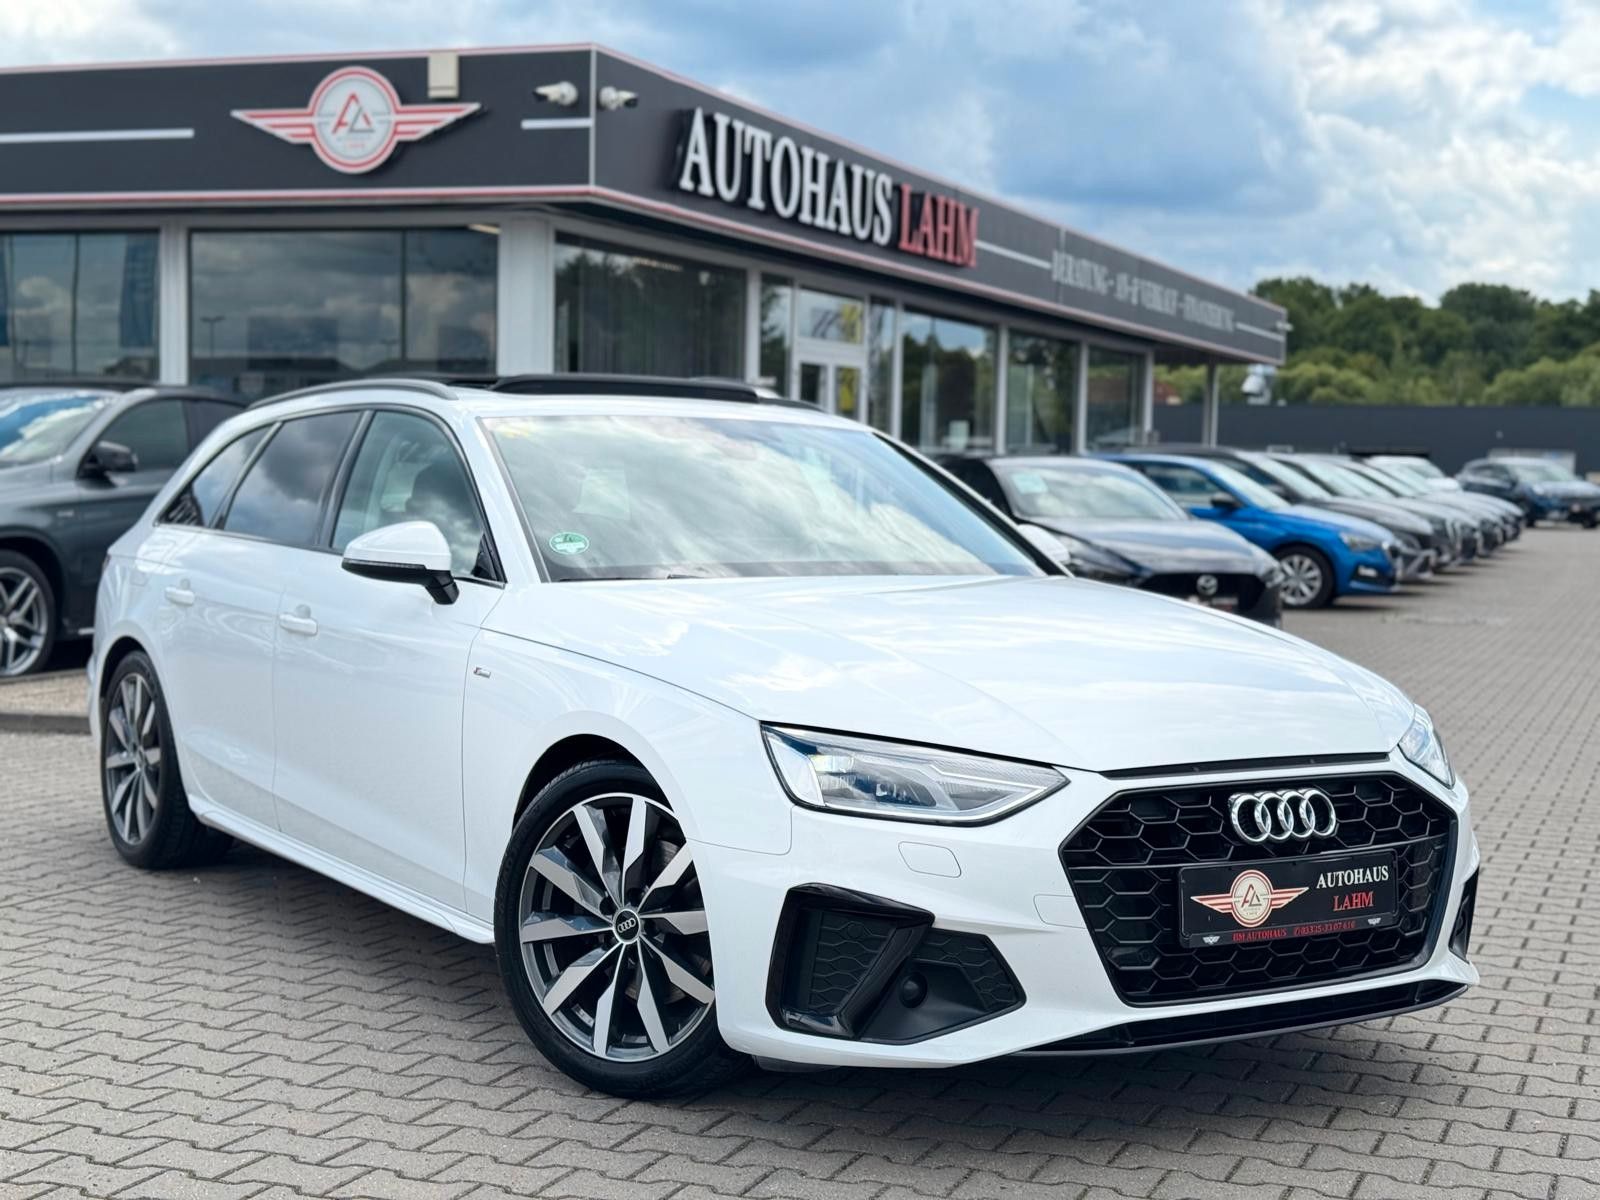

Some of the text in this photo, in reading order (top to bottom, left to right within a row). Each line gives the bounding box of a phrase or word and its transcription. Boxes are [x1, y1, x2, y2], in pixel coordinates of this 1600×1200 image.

[679, 107, 979, 267] AUTOHAUS LAHM
[1316, 865, 1389, 889] AUTOHAUS
[1333, 891, 1374, 912] LAHM
[1247, 928, 1287, 941] AUTOHAUS
